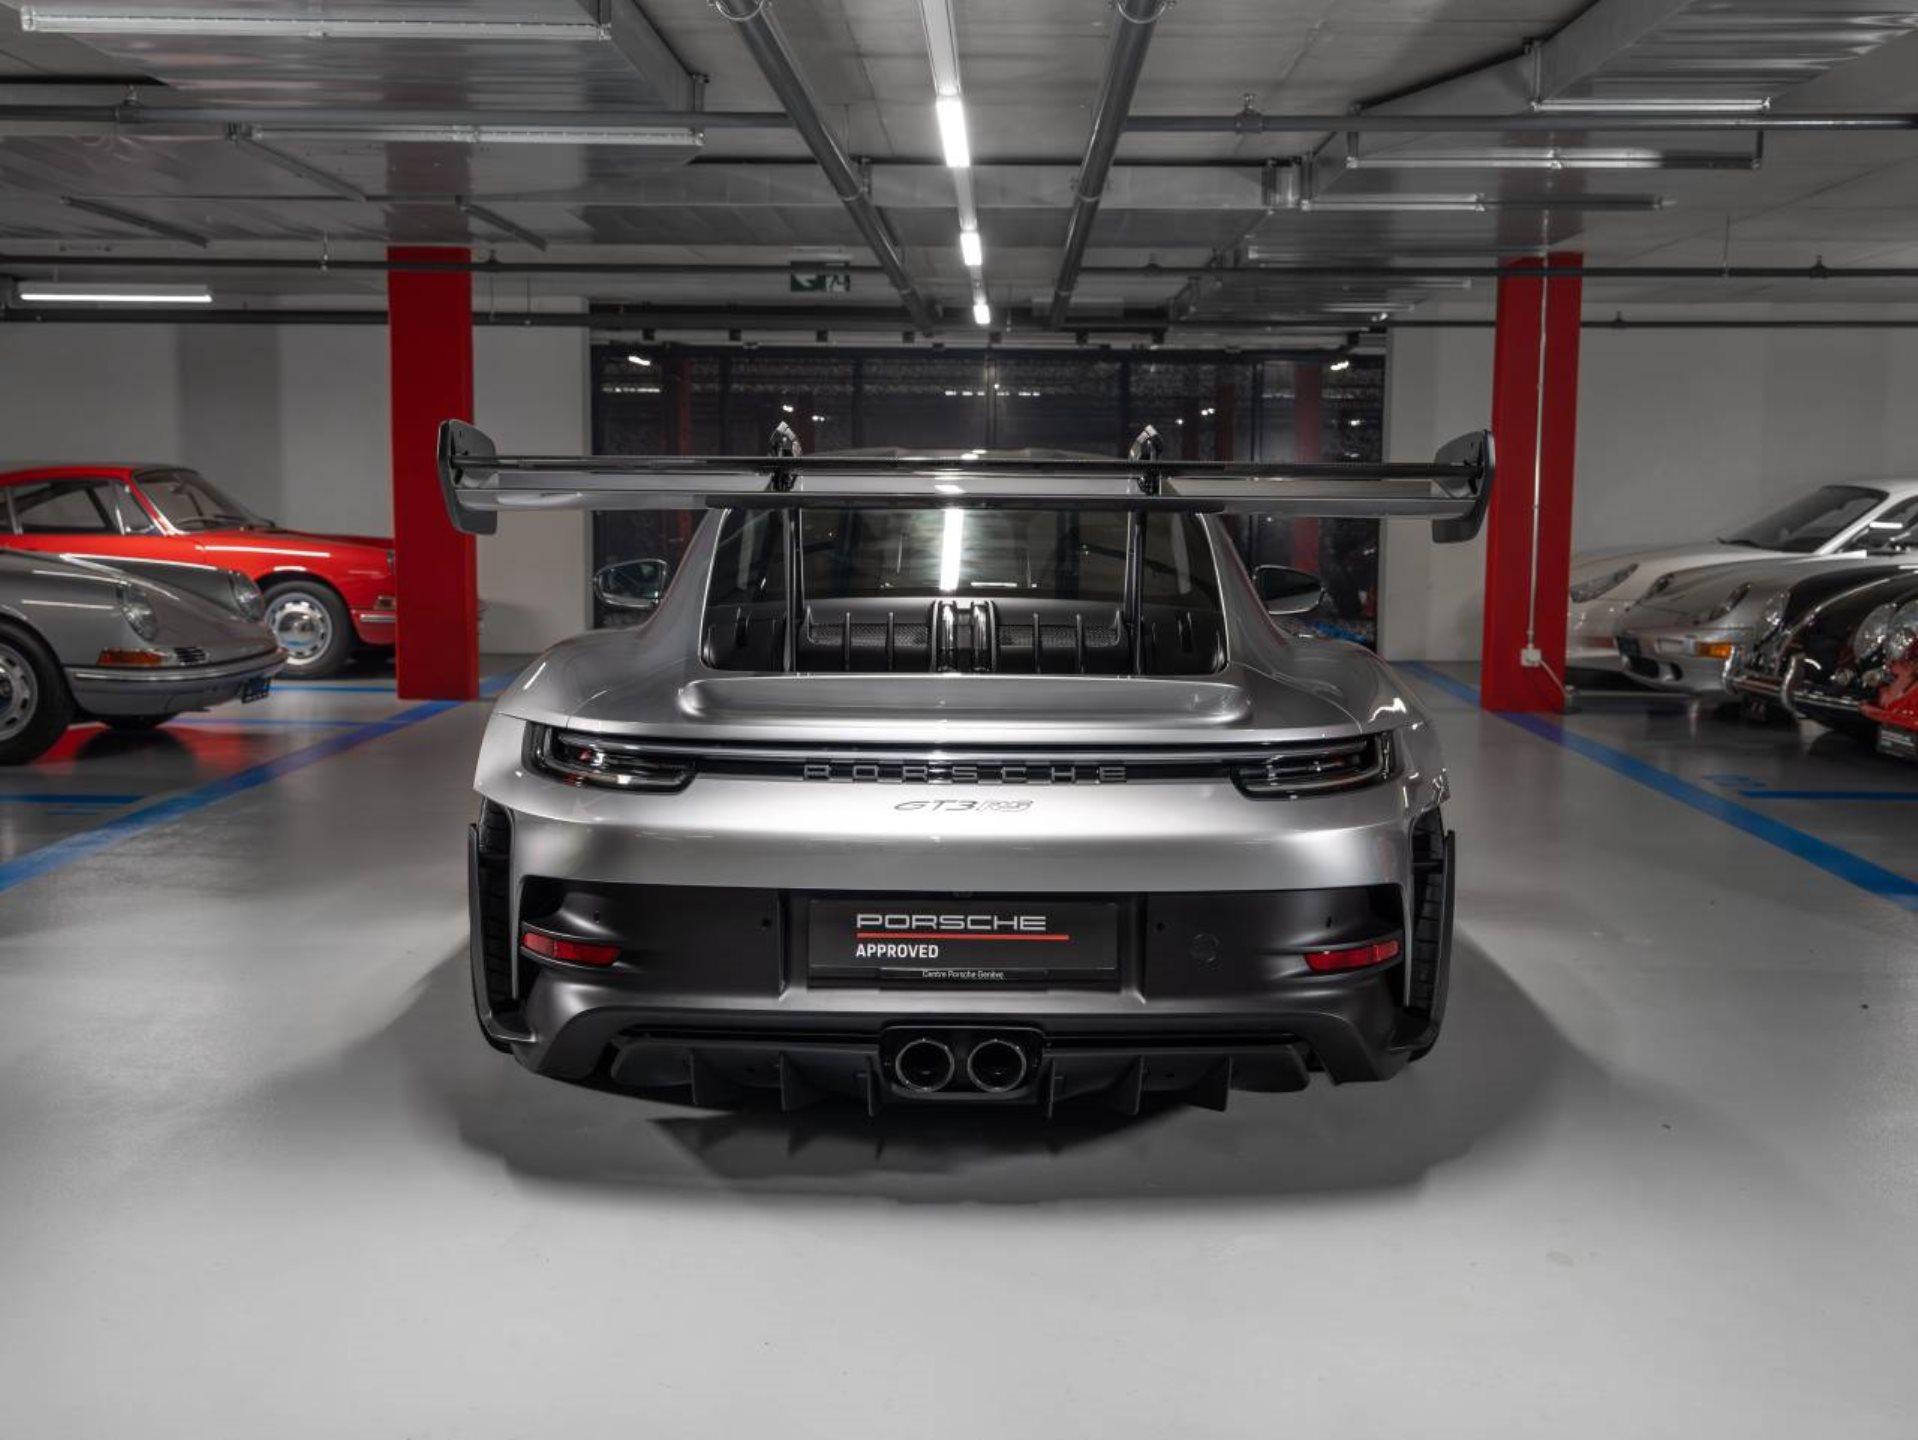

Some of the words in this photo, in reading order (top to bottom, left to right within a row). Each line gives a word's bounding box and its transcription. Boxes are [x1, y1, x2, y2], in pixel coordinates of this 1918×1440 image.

[803, 764, 1127, 784] PORSCHE
[894, 799, 977, 812] GT3
[976, 799, 1035, 813] RS
[856, 913, 1046, 931] PORSCHE
[855, 943, 939, 959] APPROVED
[922, 969, 946, 978] Centre
[948, 970, 976, 979] Porsche
